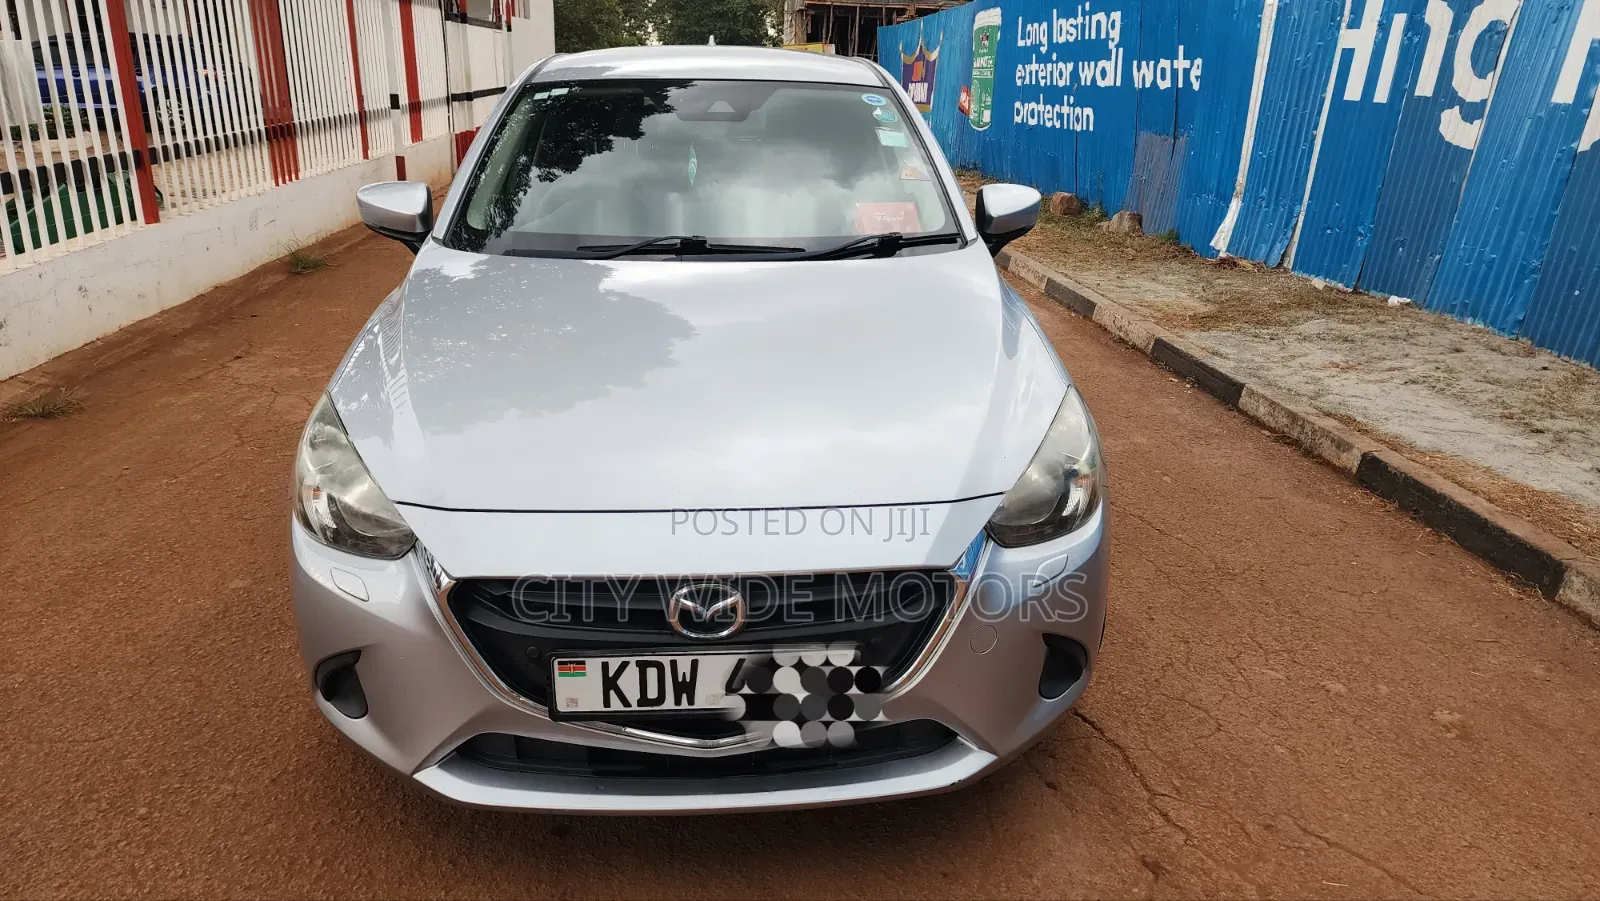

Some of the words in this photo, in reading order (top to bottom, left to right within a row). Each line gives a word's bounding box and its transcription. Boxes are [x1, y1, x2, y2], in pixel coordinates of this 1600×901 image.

[1017, 16, 1048, 54] Long
[1052, 1, 1122, 50] lasting
[1015, 52, 1074, 87] exterior
[1078, 47, 1124, 88] wall
[1013, 93, 1095, 132] protection
[601, 658, 699, 709] KDW
